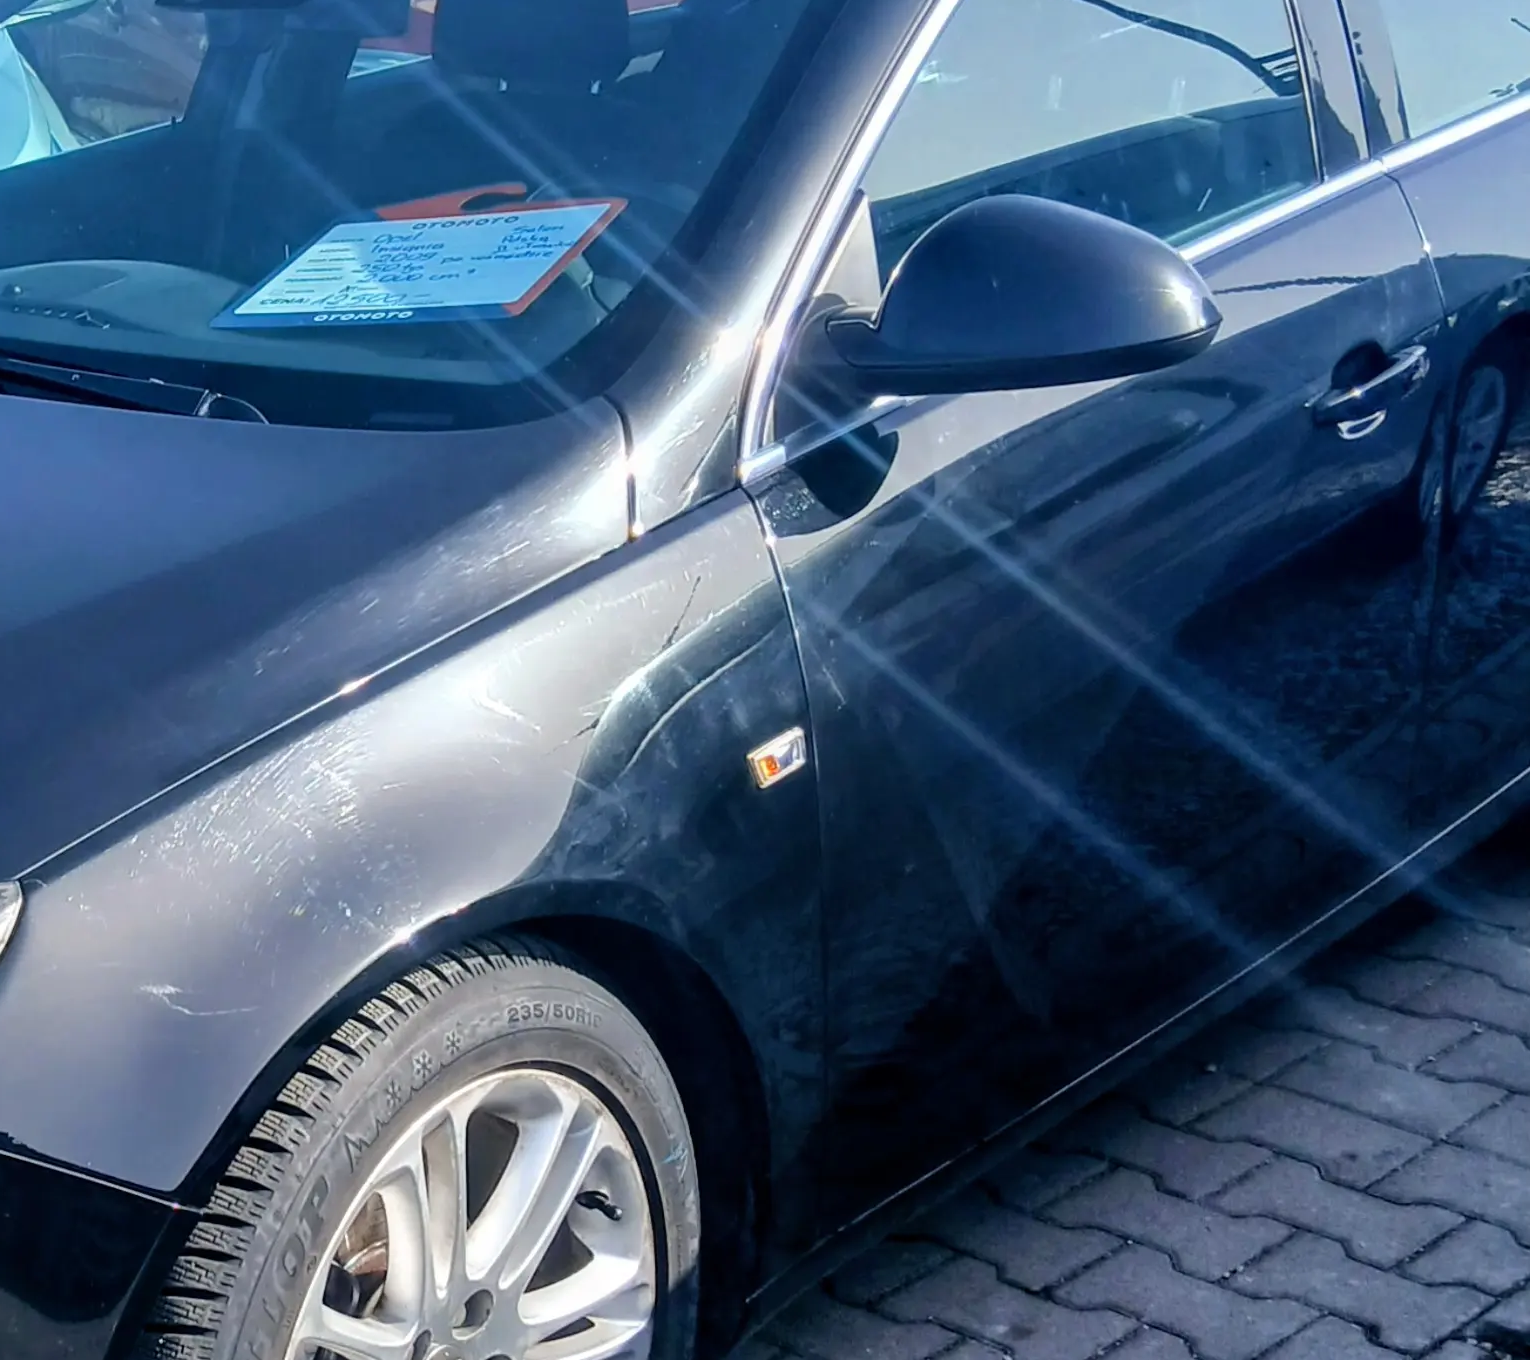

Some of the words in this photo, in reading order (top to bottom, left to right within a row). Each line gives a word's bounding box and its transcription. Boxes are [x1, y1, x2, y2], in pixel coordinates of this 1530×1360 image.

[411, 215, 521, 231] OTOMOTO
[372, 231, 424, 245] Opel
[313, 310, 415, 323] OTOMOTO
